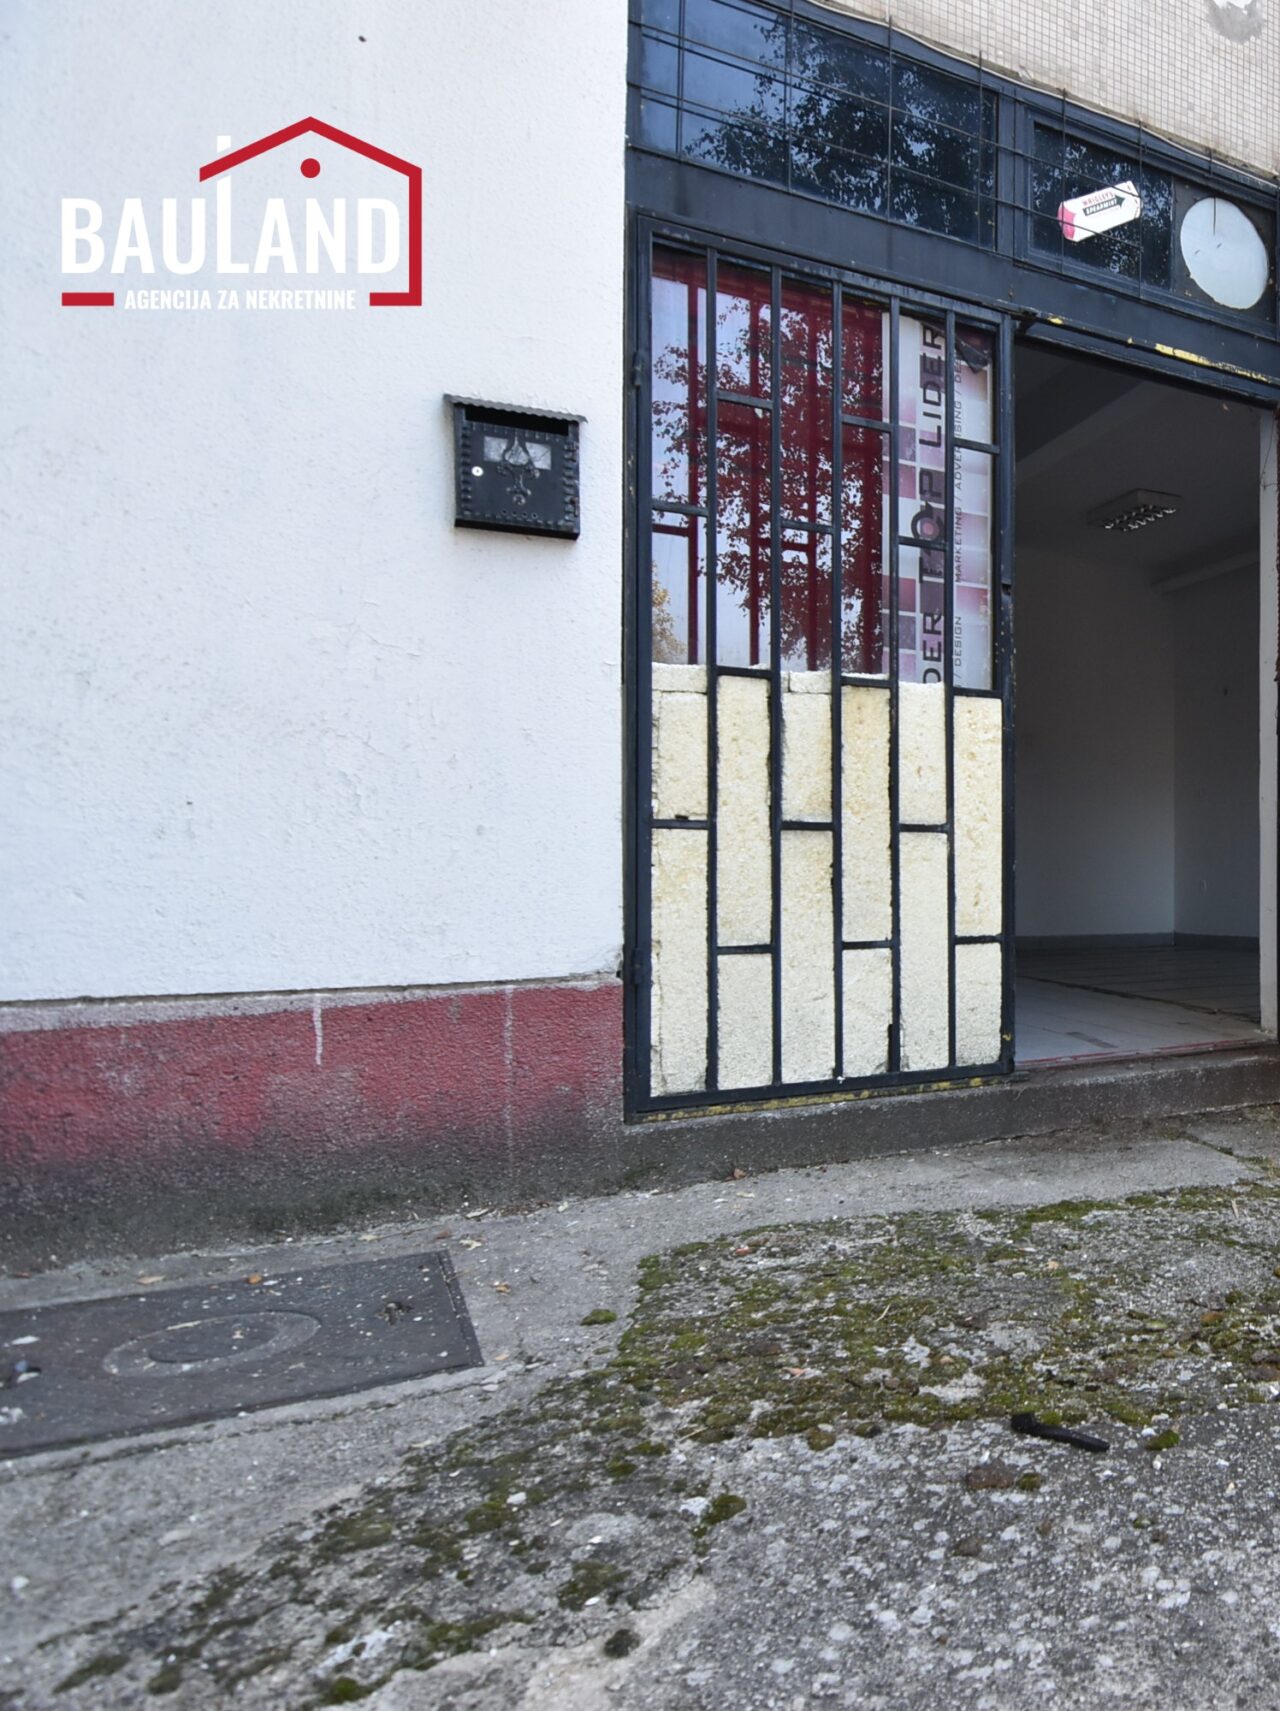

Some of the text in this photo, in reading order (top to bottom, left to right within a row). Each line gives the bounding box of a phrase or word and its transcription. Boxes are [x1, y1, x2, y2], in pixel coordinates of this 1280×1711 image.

[918, 325, 946, 448] LIDER
[953, 401, 963, 490] ADVERISING
[953, 505, 963, 584] MARKETING
[954, 615, 963, 667] DESIGN
